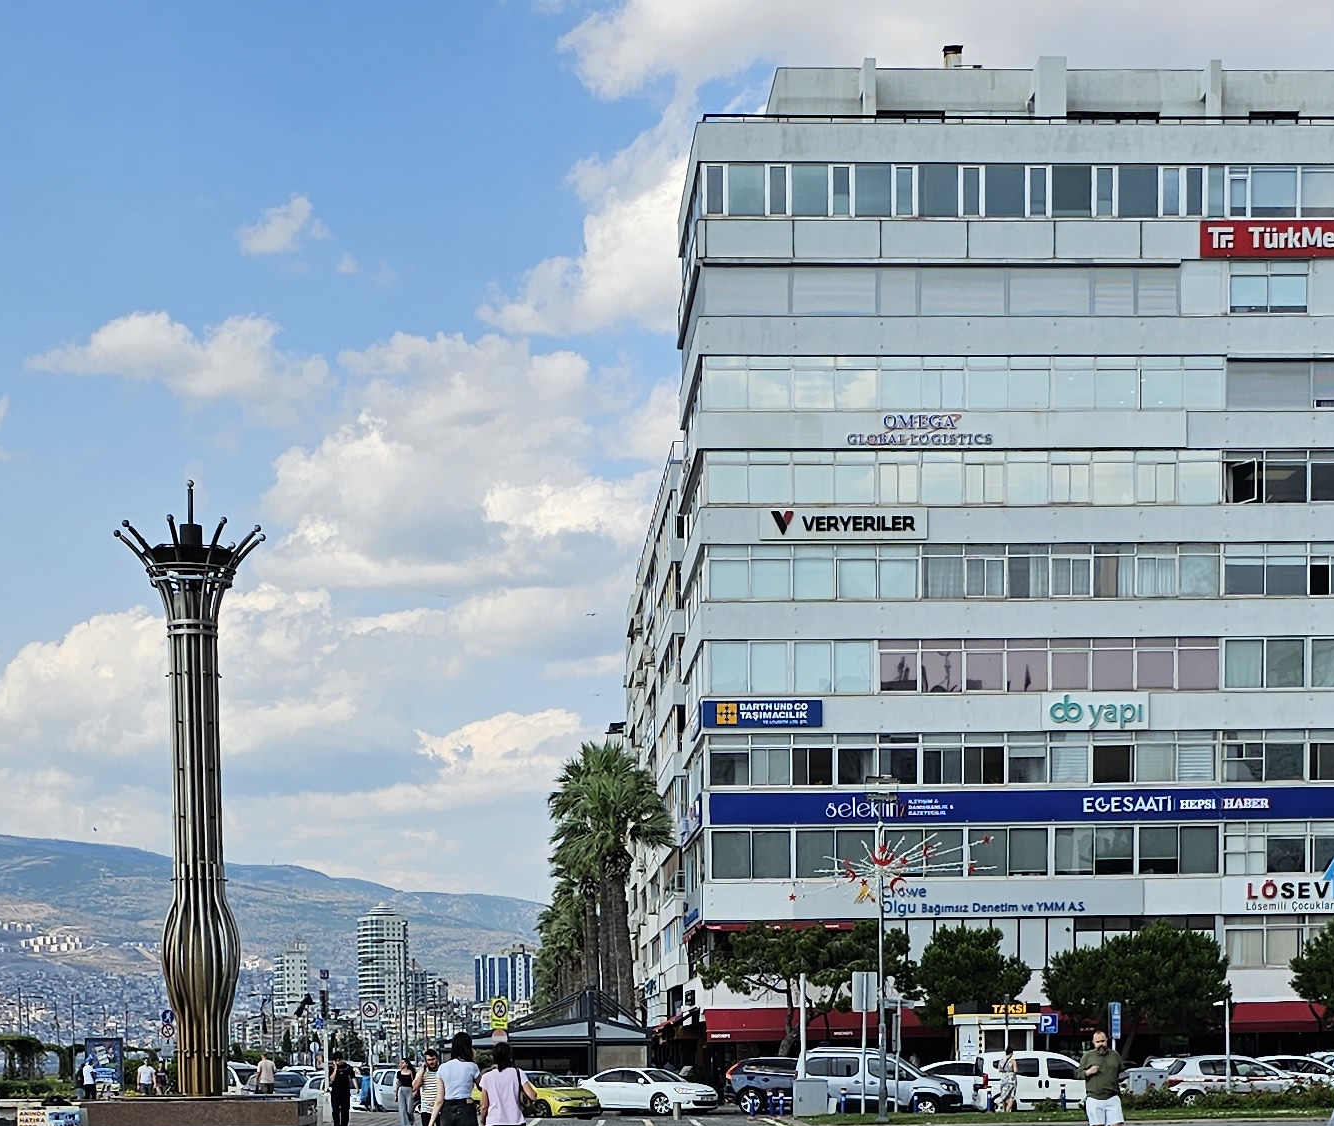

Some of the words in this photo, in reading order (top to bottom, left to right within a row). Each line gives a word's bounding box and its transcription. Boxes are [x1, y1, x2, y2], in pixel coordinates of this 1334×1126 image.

[883, 414, 957, 429] OMEGA
[847, 433, 904, 445] GLOBAL
[911, 433, 993, 445] LOGISTICS
[801, 515, 916, 531] VERYERILER
[739, 703, 773, 711] BARTH
[774, 703, 793, 711] UND
[794, 703, 809, 711] CO
[1223, 797, 1270, 809] HABER
[1247, 879, 1331, 899] LÖSEV
[882, 900, 917, 916] Olgu
[972, 902, 1018, 912] Denetim
[1021, 903, 1034, 911] ve
[1036, 902, 1066, 912] YMM
[1246, 901, 1287, 910] Lösemili
[1291, 901, 1334, 912] Çocuklar
[992, 1002, 1027, 1014] TAKSİ
[1040, 1015, 1053, 1032] P
